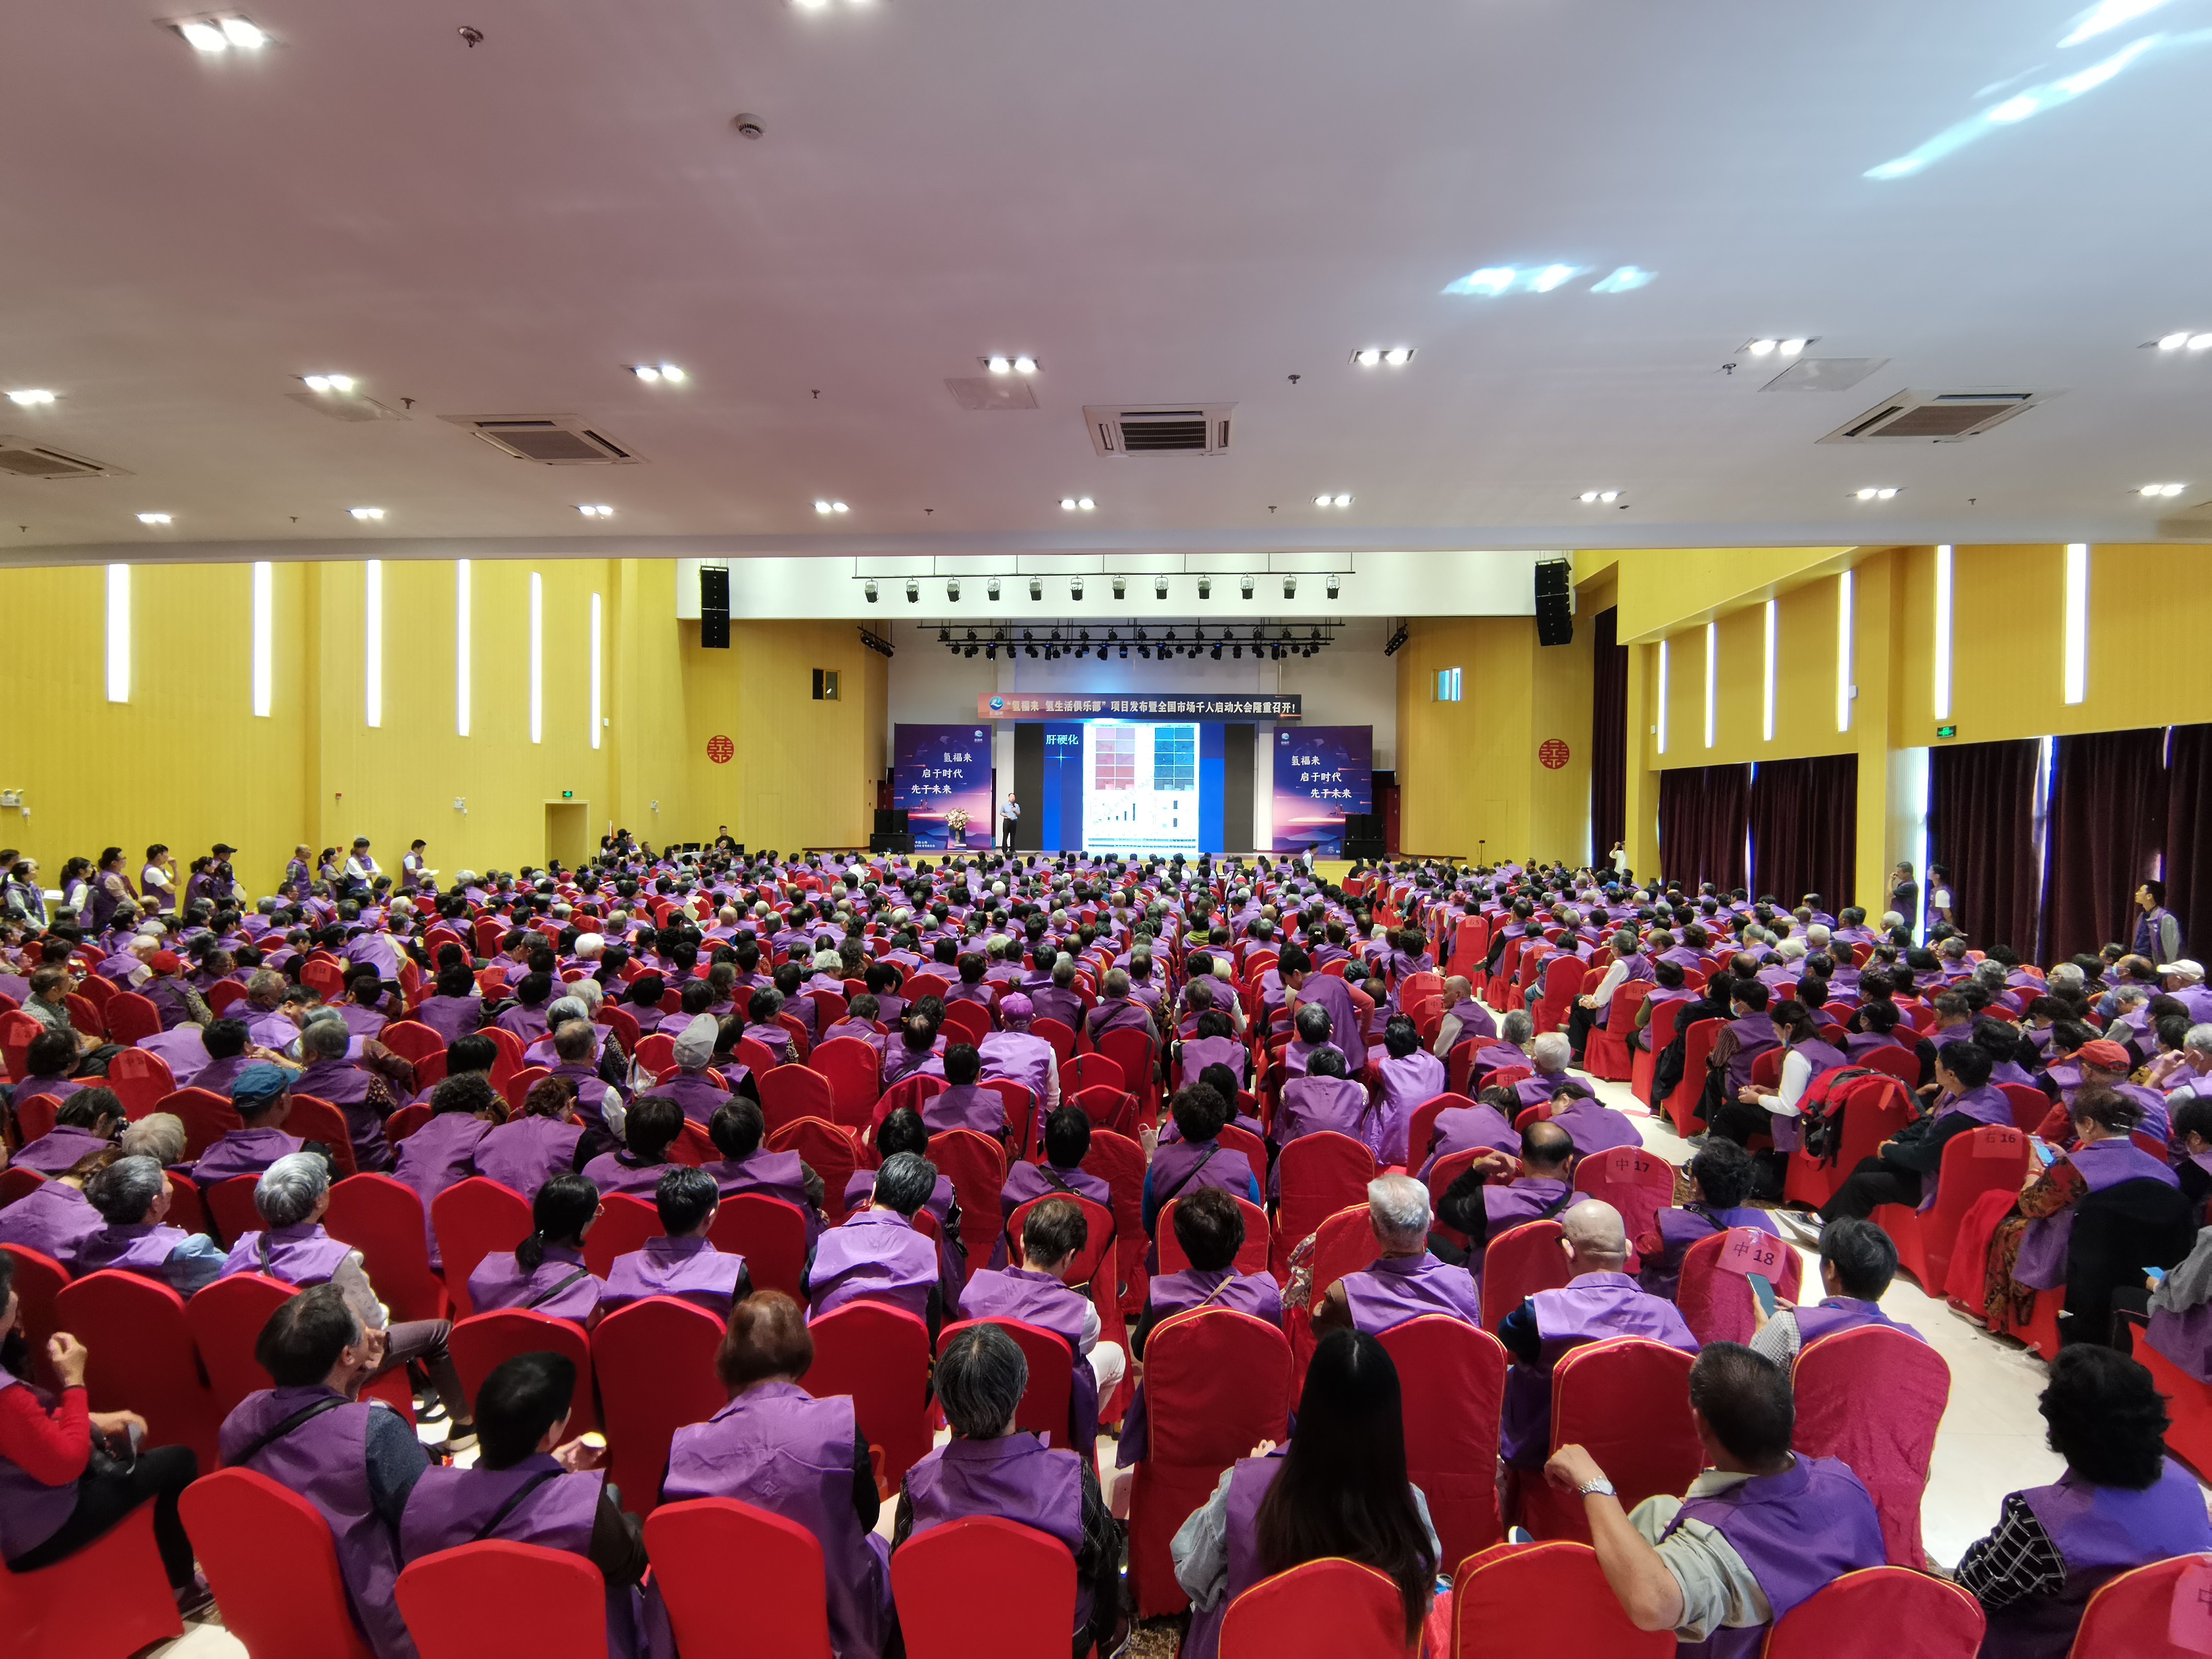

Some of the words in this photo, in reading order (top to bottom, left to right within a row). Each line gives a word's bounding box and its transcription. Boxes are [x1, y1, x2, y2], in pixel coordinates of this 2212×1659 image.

[1046, 734, 1079, 745] 肝硬化
[943, 752, 973, 762] 氢福来
[1291, 756, 1320, 766] 氢福来
[922, 769, 963, 778] 启于时代
[1300, 771, 1342, 782] 启于时代
[912, 784, 952, 794] 先于未来
[1310, 788, 1352, 799] 先于未来
[1431, 1000, 1438, 1009] 中
[1504, 1074, 1513, 1084] 中
[2000, 1134, 2016, 1143] 16
[1616, 1157, 1629, 1170] 中
[1634, 1161, 1650, 1172] 17
[1733, 1241, 1749, 1257] 中
[1753, 1249, 1775, 1265] 18
